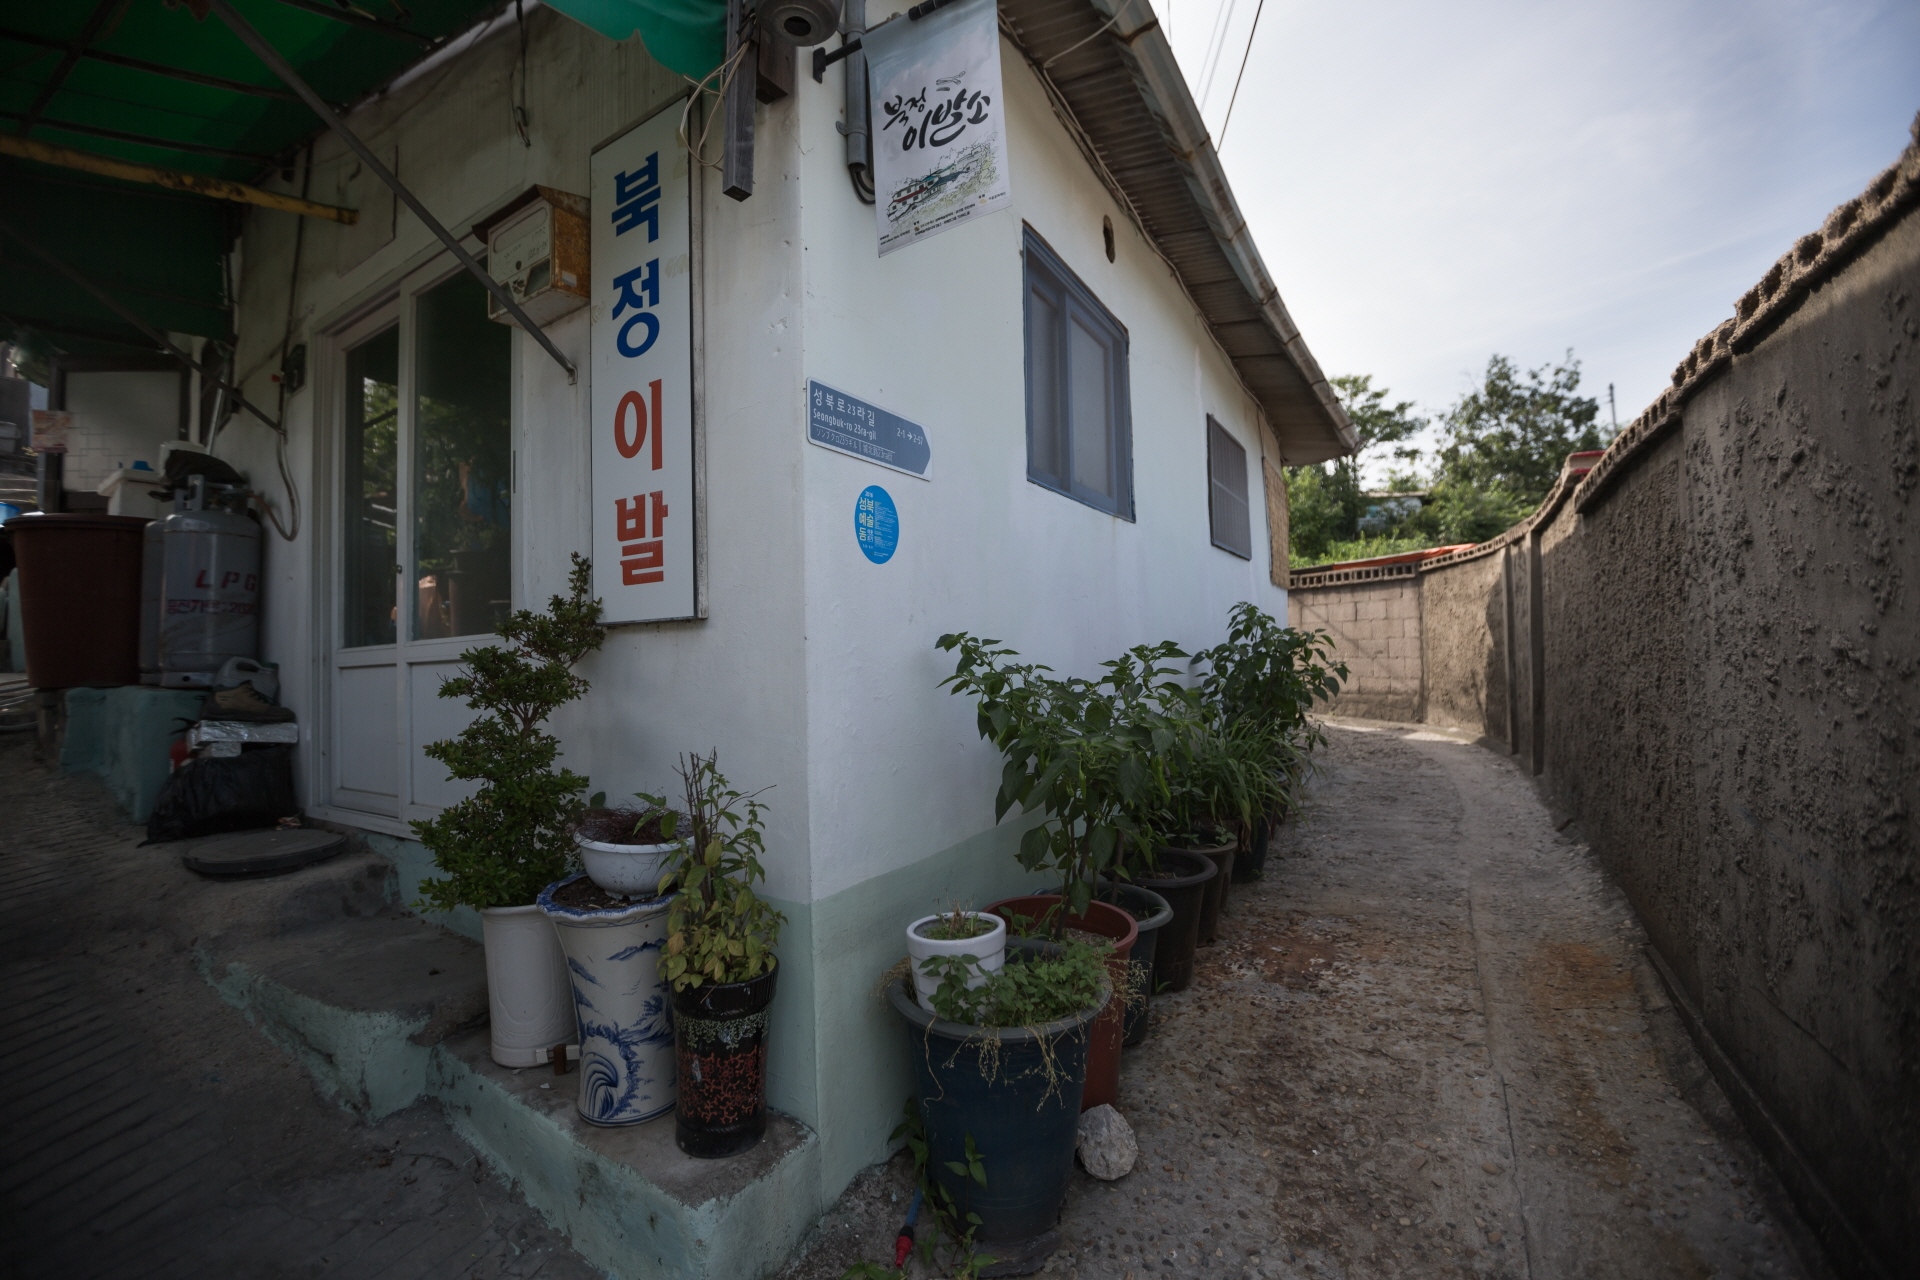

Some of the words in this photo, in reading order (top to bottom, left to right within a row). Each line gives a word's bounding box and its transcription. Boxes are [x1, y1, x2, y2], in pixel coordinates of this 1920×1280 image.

[902, 88, 990, 151] 이발소
[813, 408, 853, 431] Seongbuk-ro
[853, 423, 877, 441] 23ra-gil
[196, 570, 257, 592] LPG
